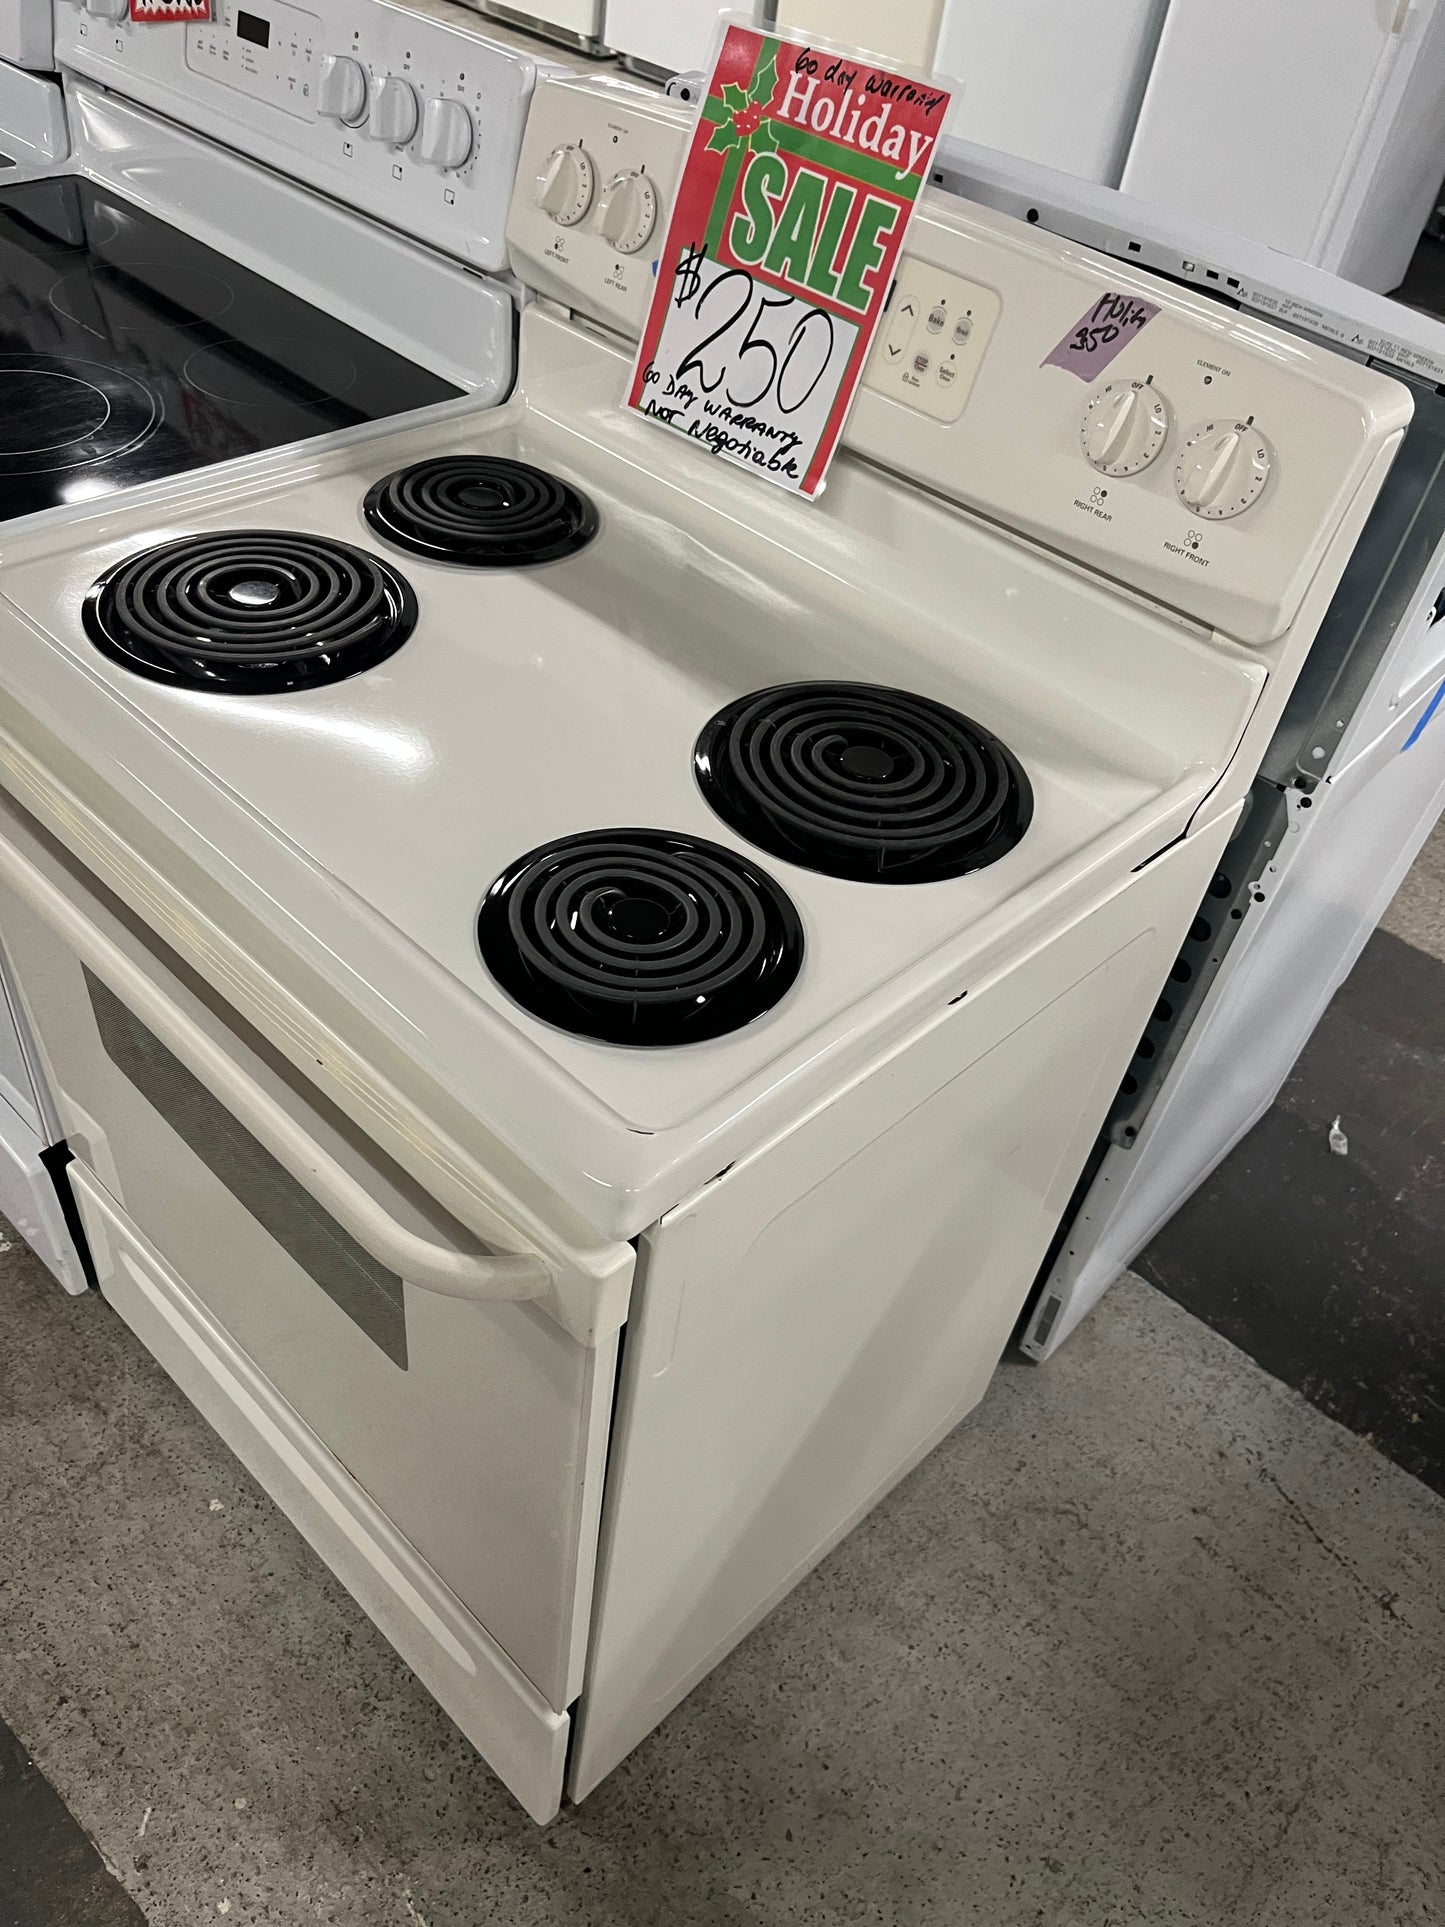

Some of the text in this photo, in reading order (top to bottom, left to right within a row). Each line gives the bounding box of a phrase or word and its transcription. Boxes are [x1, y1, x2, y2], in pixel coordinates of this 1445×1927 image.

[795, 47, 818, 74] 60
[776, 70, 934, 181] Holiday
[728, 151, 901, 315] SALE
[555, 253, 569, 265] FRONT
[615, 281, 628, 292] REAR
[928, 313, 945, 327] Bake
[1069, 324, 1119, 352] 350
[1197, 359, 1231, 377] ELEMENT ON
[1131, 382, 1144, 390] OFF
[643, 361, 660, 384] 60
[704, 400, 803, 454] WARRANTY
[644, 399, 685, 424] NOT
[1154, 403, 1162, 413] LO
[1234, 423, 1248, 432] OFF
[1257, 448, 1265, 459] LO
[1073, 499, 1113, 522] RIGHT REAR
[1163, 541, 1210, 568] RIGHT FRONT
